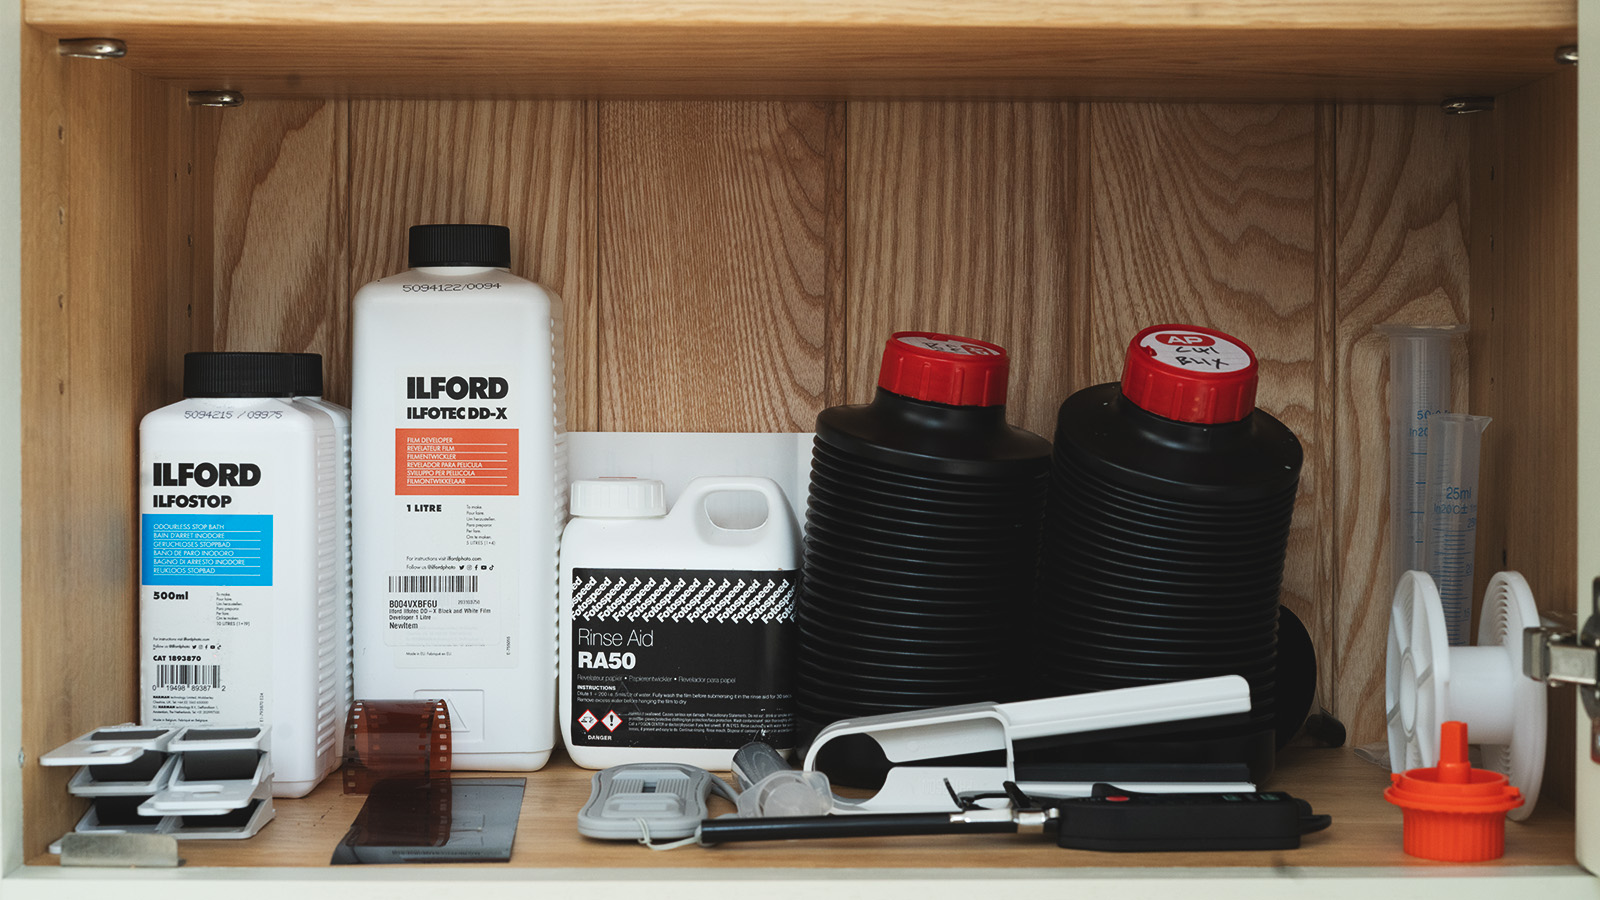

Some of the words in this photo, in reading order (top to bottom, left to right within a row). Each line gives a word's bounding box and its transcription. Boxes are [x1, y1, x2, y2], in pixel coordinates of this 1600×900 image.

[403, 283, 501, 292] 5094122/0094
[1168, 336, 1203, 344] AP
[407, 376, 509, 400] ILFORD
[184, 410, 233, 419] 5094215
[407, 407, 466, 420] ILFOTEC
[468, 407, 508, 420] DD-X
[153, 462, 262, 488] ILFORD
[153, 495, 232, 508] ILFOSTOP
[407, 504, 411, 512] 1
[414, 504, 442, 512] LITRE
[153, 548, 173, 556] BAÑO
[153, 591, 189, 600] 500ml
[389, 600, 438, 608] B004VXBF6U
[582, 576, 627, 622] Fotospeed
[597, 576, 642, 622] Fotospeed
[612, 576, 657, 622] Fotospeed
[627, 577, 672, 622] Fotospeed
[642, 577, 687, 623] Fotospeed
[656, 577, 701, 623] Fotospeed
[671, 577, 716, 623] Fotospeed
[686, 578, 731, 624] Fotospeed
[701, 578, 746, 624] Fotospeed
[716, 578, 761, 624] Fotospeed
[731, 578, 776, 624] Fotospeed
[745, 578, 790, 625] Fotospeed
[389, 622, 419, 630] NewItem
[578, 628, 623, 647] Rinse
[627, 629, 654, 648] Aid
[578, 651, 636, 670] RA50
